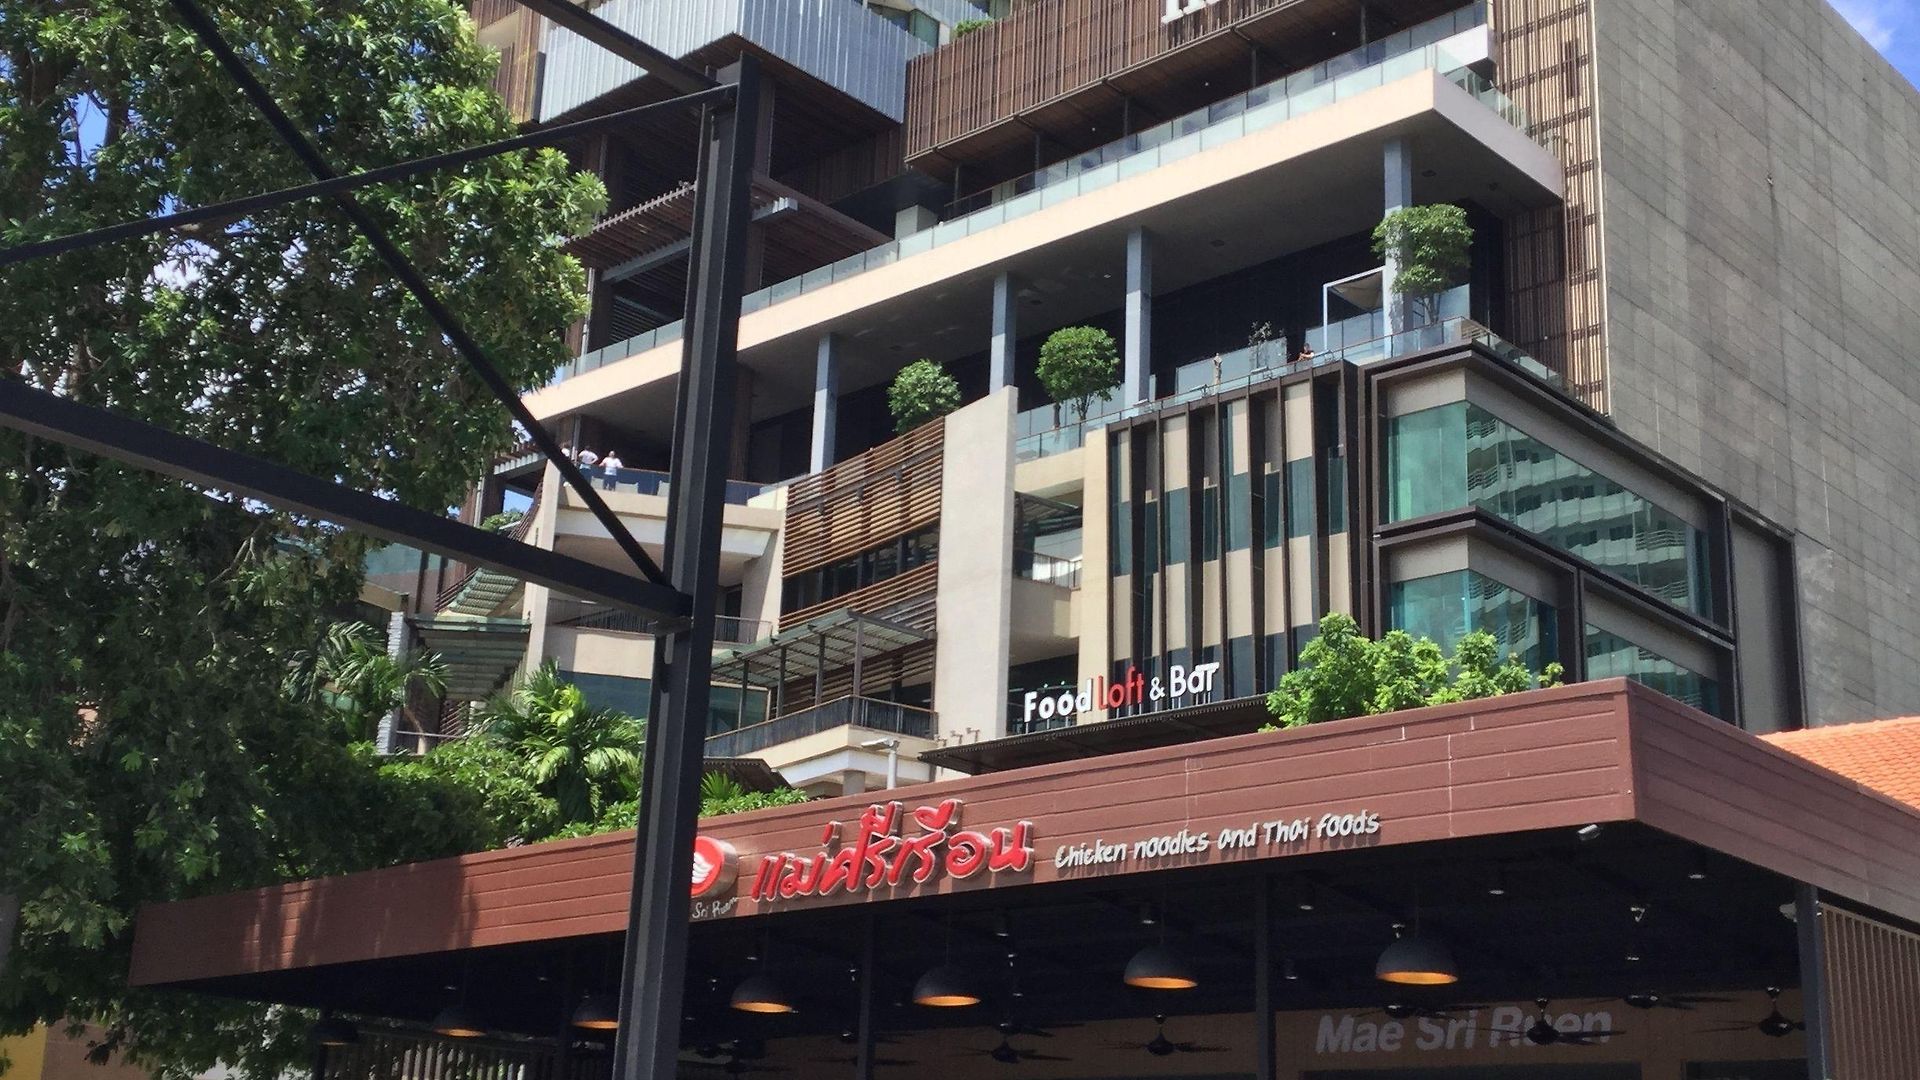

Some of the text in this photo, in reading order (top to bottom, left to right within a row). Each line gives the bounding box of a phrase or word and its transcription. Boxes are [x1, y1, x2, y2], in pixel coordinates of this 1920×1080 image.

[1024, 678, 1093, 723] Food
[1098, 665, 1145, 711] Loft
[1150, 676, 1165, 701] &
[1055, 809, 1381, 868] Chicken noodles and Thai foods
[691, 901, 709, 919] Sri
[1315, 1013, 1405, 1054] Mae
[1416, 1010, 1477, 1050] Sri
